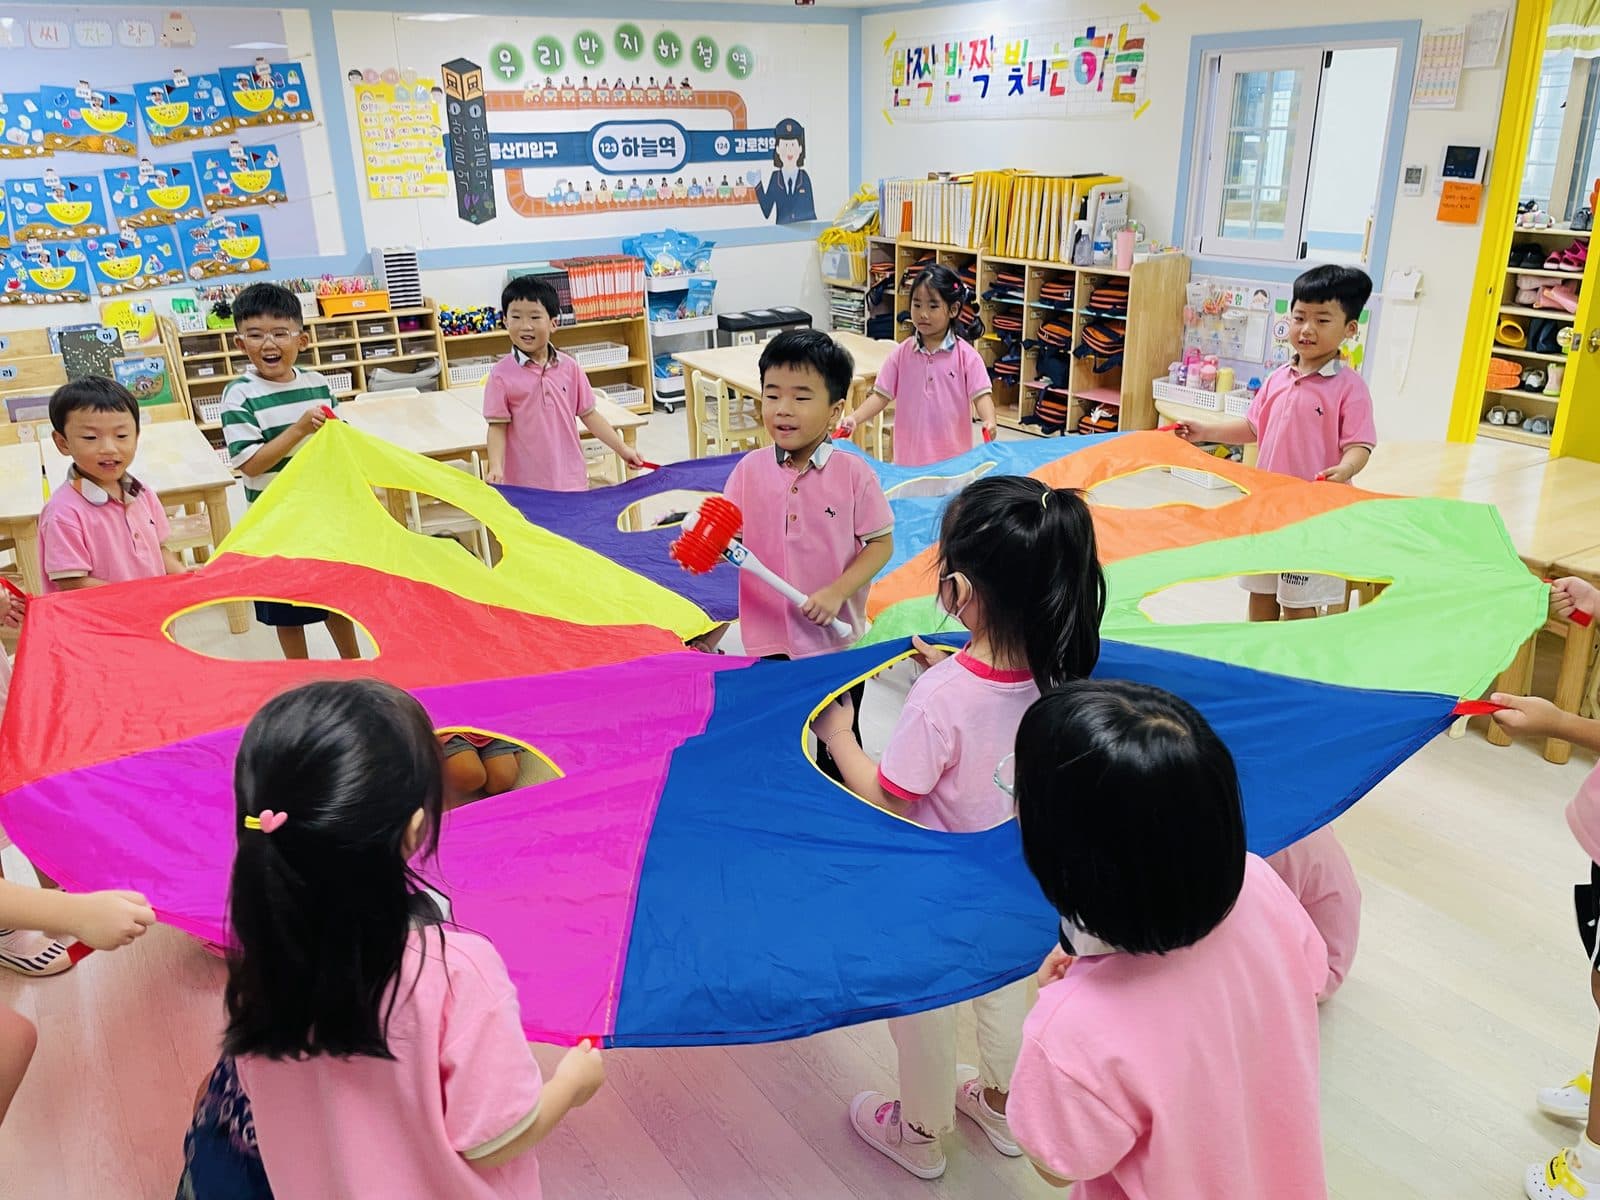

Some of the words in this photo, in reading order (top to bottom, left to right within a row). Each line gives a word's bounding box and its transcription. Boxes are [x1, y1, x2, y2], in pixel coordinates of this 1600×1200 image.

[1073, 23, 1146, 103] 하늘
[472, 124, 488, 189] 하늘역
[600, 142, 617, 153] 123
[621, 136, 676, 158] 하늘역
